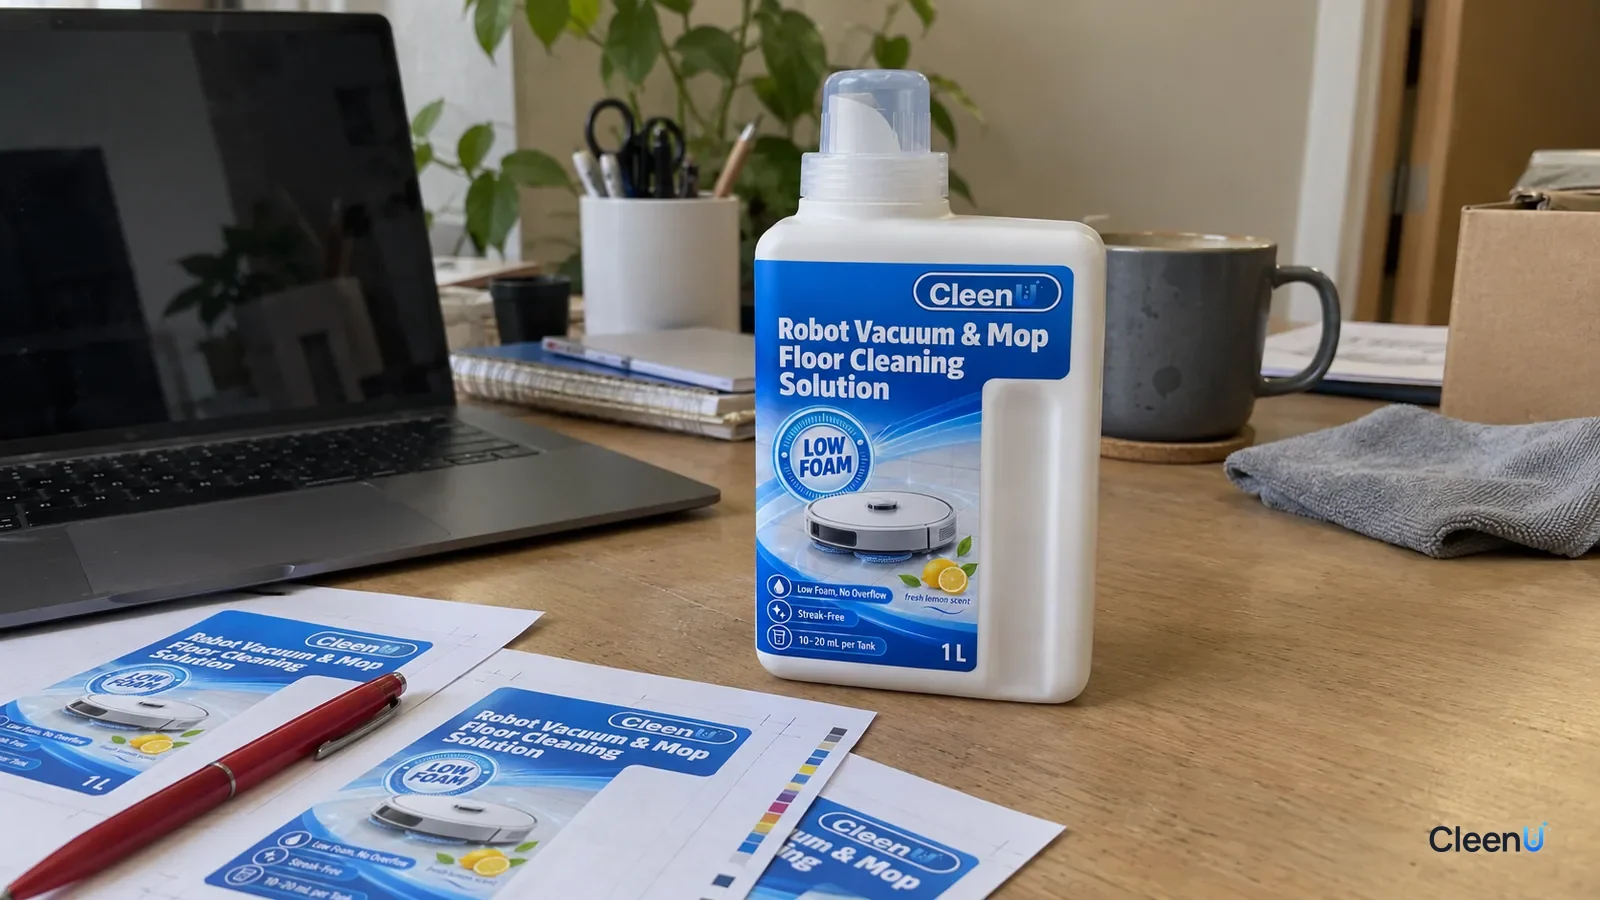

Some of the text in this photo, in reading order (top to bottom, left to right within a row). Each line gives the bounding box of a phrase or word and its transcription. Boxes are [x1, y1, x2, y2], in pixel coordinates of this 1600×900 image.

[778, 317, 1049, 353] Robot Vacuum & Mop
[779, 345, 965, 380] Floor Cleaning
[779, 371, 890, 401] Solution
[803, 436, 846, 458] LOW
[799, 455, 853, 478] FOAM
[797, 584, 887, 600] Low Foam, No Overflow
[904, 593, 971, 605] fresh lemon scent
[798, 609, 845, 622] Streak-Free
[184, 632, 384, 673] Robot Vacuum & Mop
[827, 638, 839, 648] mL
[841, 641, 855, 650] per
[857, 640, 876, 651] Tank
[149, 649, 236, 671] Solution
[166, 641, 308, 673] Floor Cleaning
[106, 678, 162, 690] FOAM
[125, 672, 169, 683] LOW
[442, 731, 545, 759] Solution
[458, 720, 625, 761] Floor Cleaning
[474, 709, 710, 762] Robot Vacuum & Mop
[408, 771, 470, 786] FOAM
[425, 762, 476, 775] LOW
[831, 846, 858, 864] &
[853, 854, 921, 891] Mop
